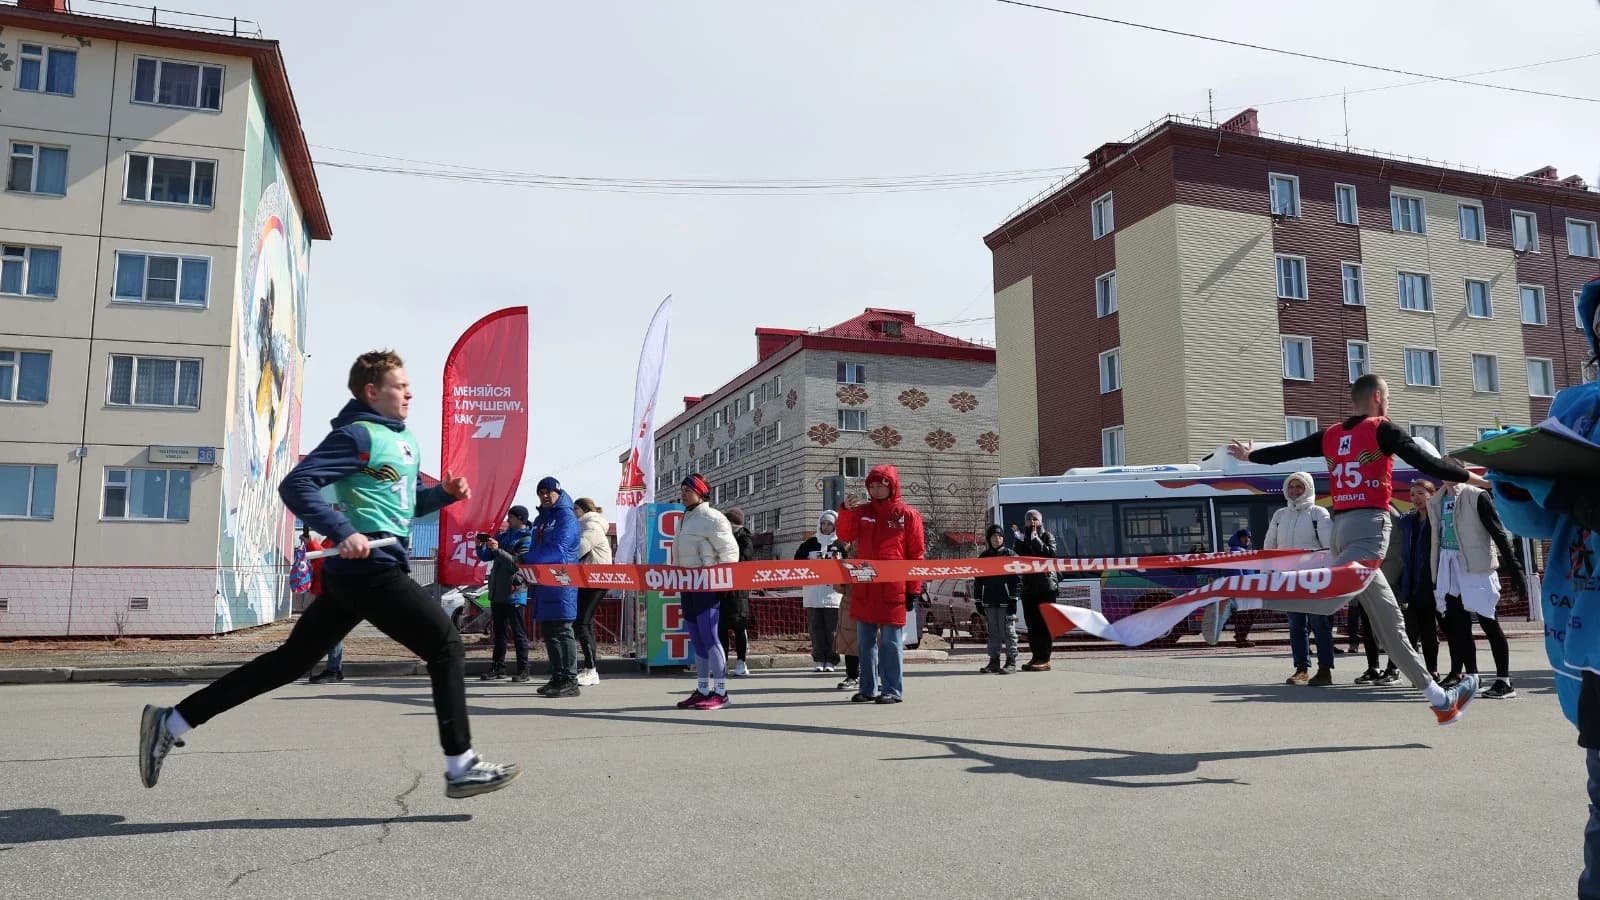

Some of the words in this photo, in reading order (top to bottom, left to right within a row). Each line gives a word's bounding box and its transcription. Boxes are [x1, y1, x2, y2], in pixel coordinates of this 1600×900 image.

[453, 384, 511, 397] МЕНЯЙСЯ
[462, 400, 524, 413] ЛУЧШЕМУ,
[454, 414, 474, 424] КАК
[1332, 461, 1363, 489] 15
[1364, 479, 1380, 488] 10
[1003, 557, 1139, 575] ФИНИШ
[645, 567, 733, 590] ФИНИШ
